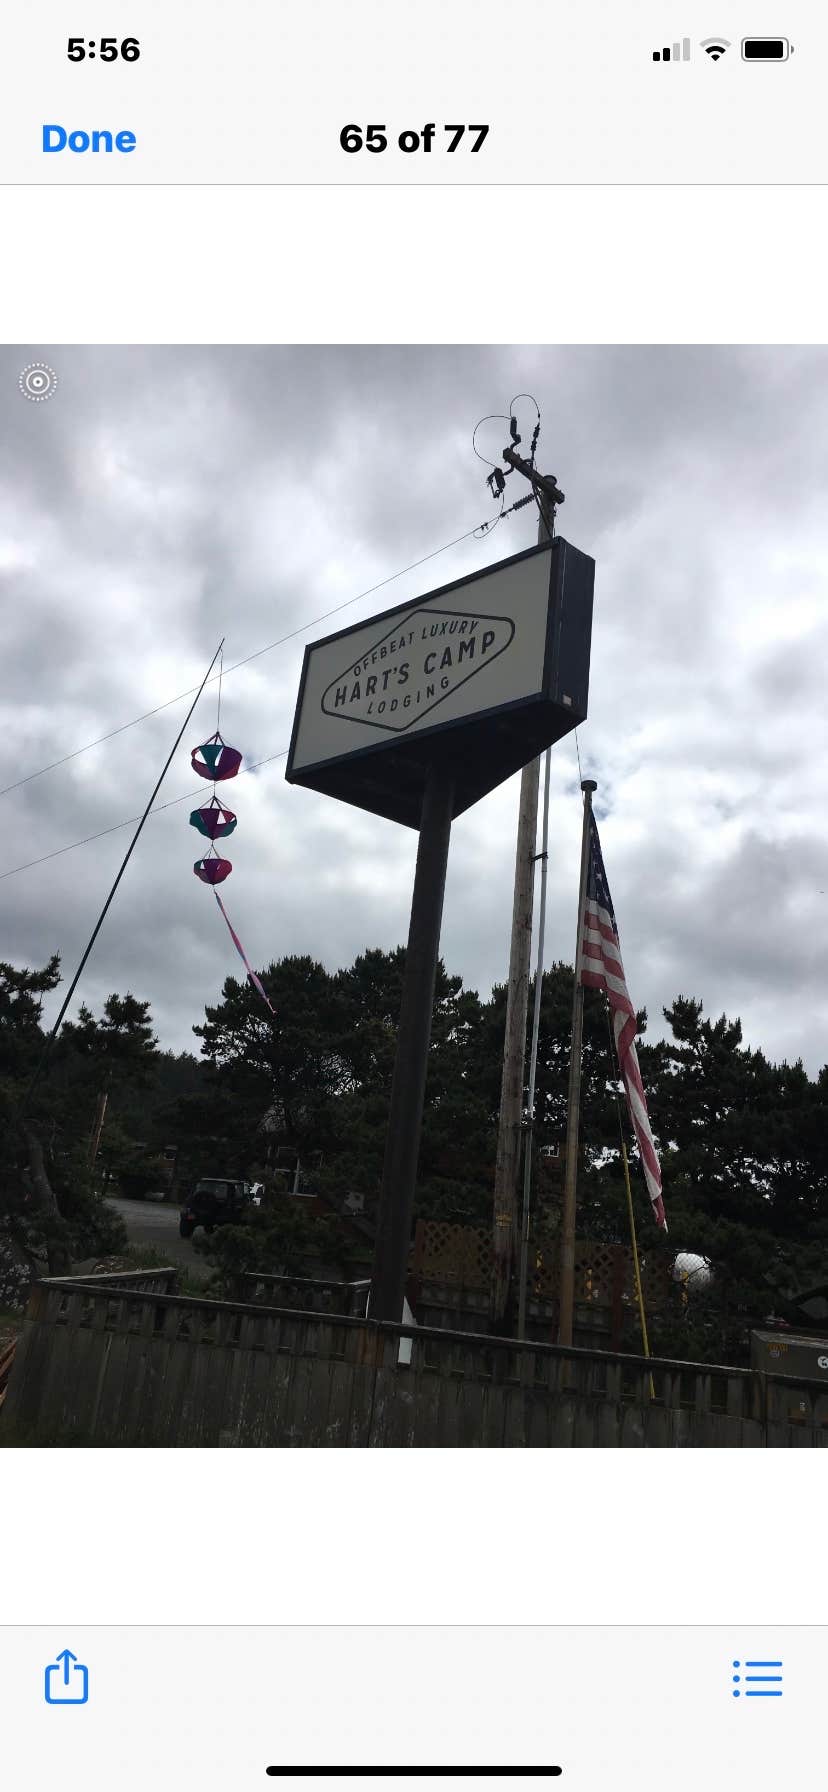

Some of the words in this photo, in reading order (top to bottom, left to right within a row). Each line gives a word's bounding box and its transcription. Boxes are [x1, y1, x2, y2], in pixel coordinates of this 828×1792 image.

[354, 632, 414, 677] OFFBEAT
[421, 620, 479, 640] LUXURY
[424, 631, 495, 674] CAMP
[367, 676, 450, 715] LODGING
